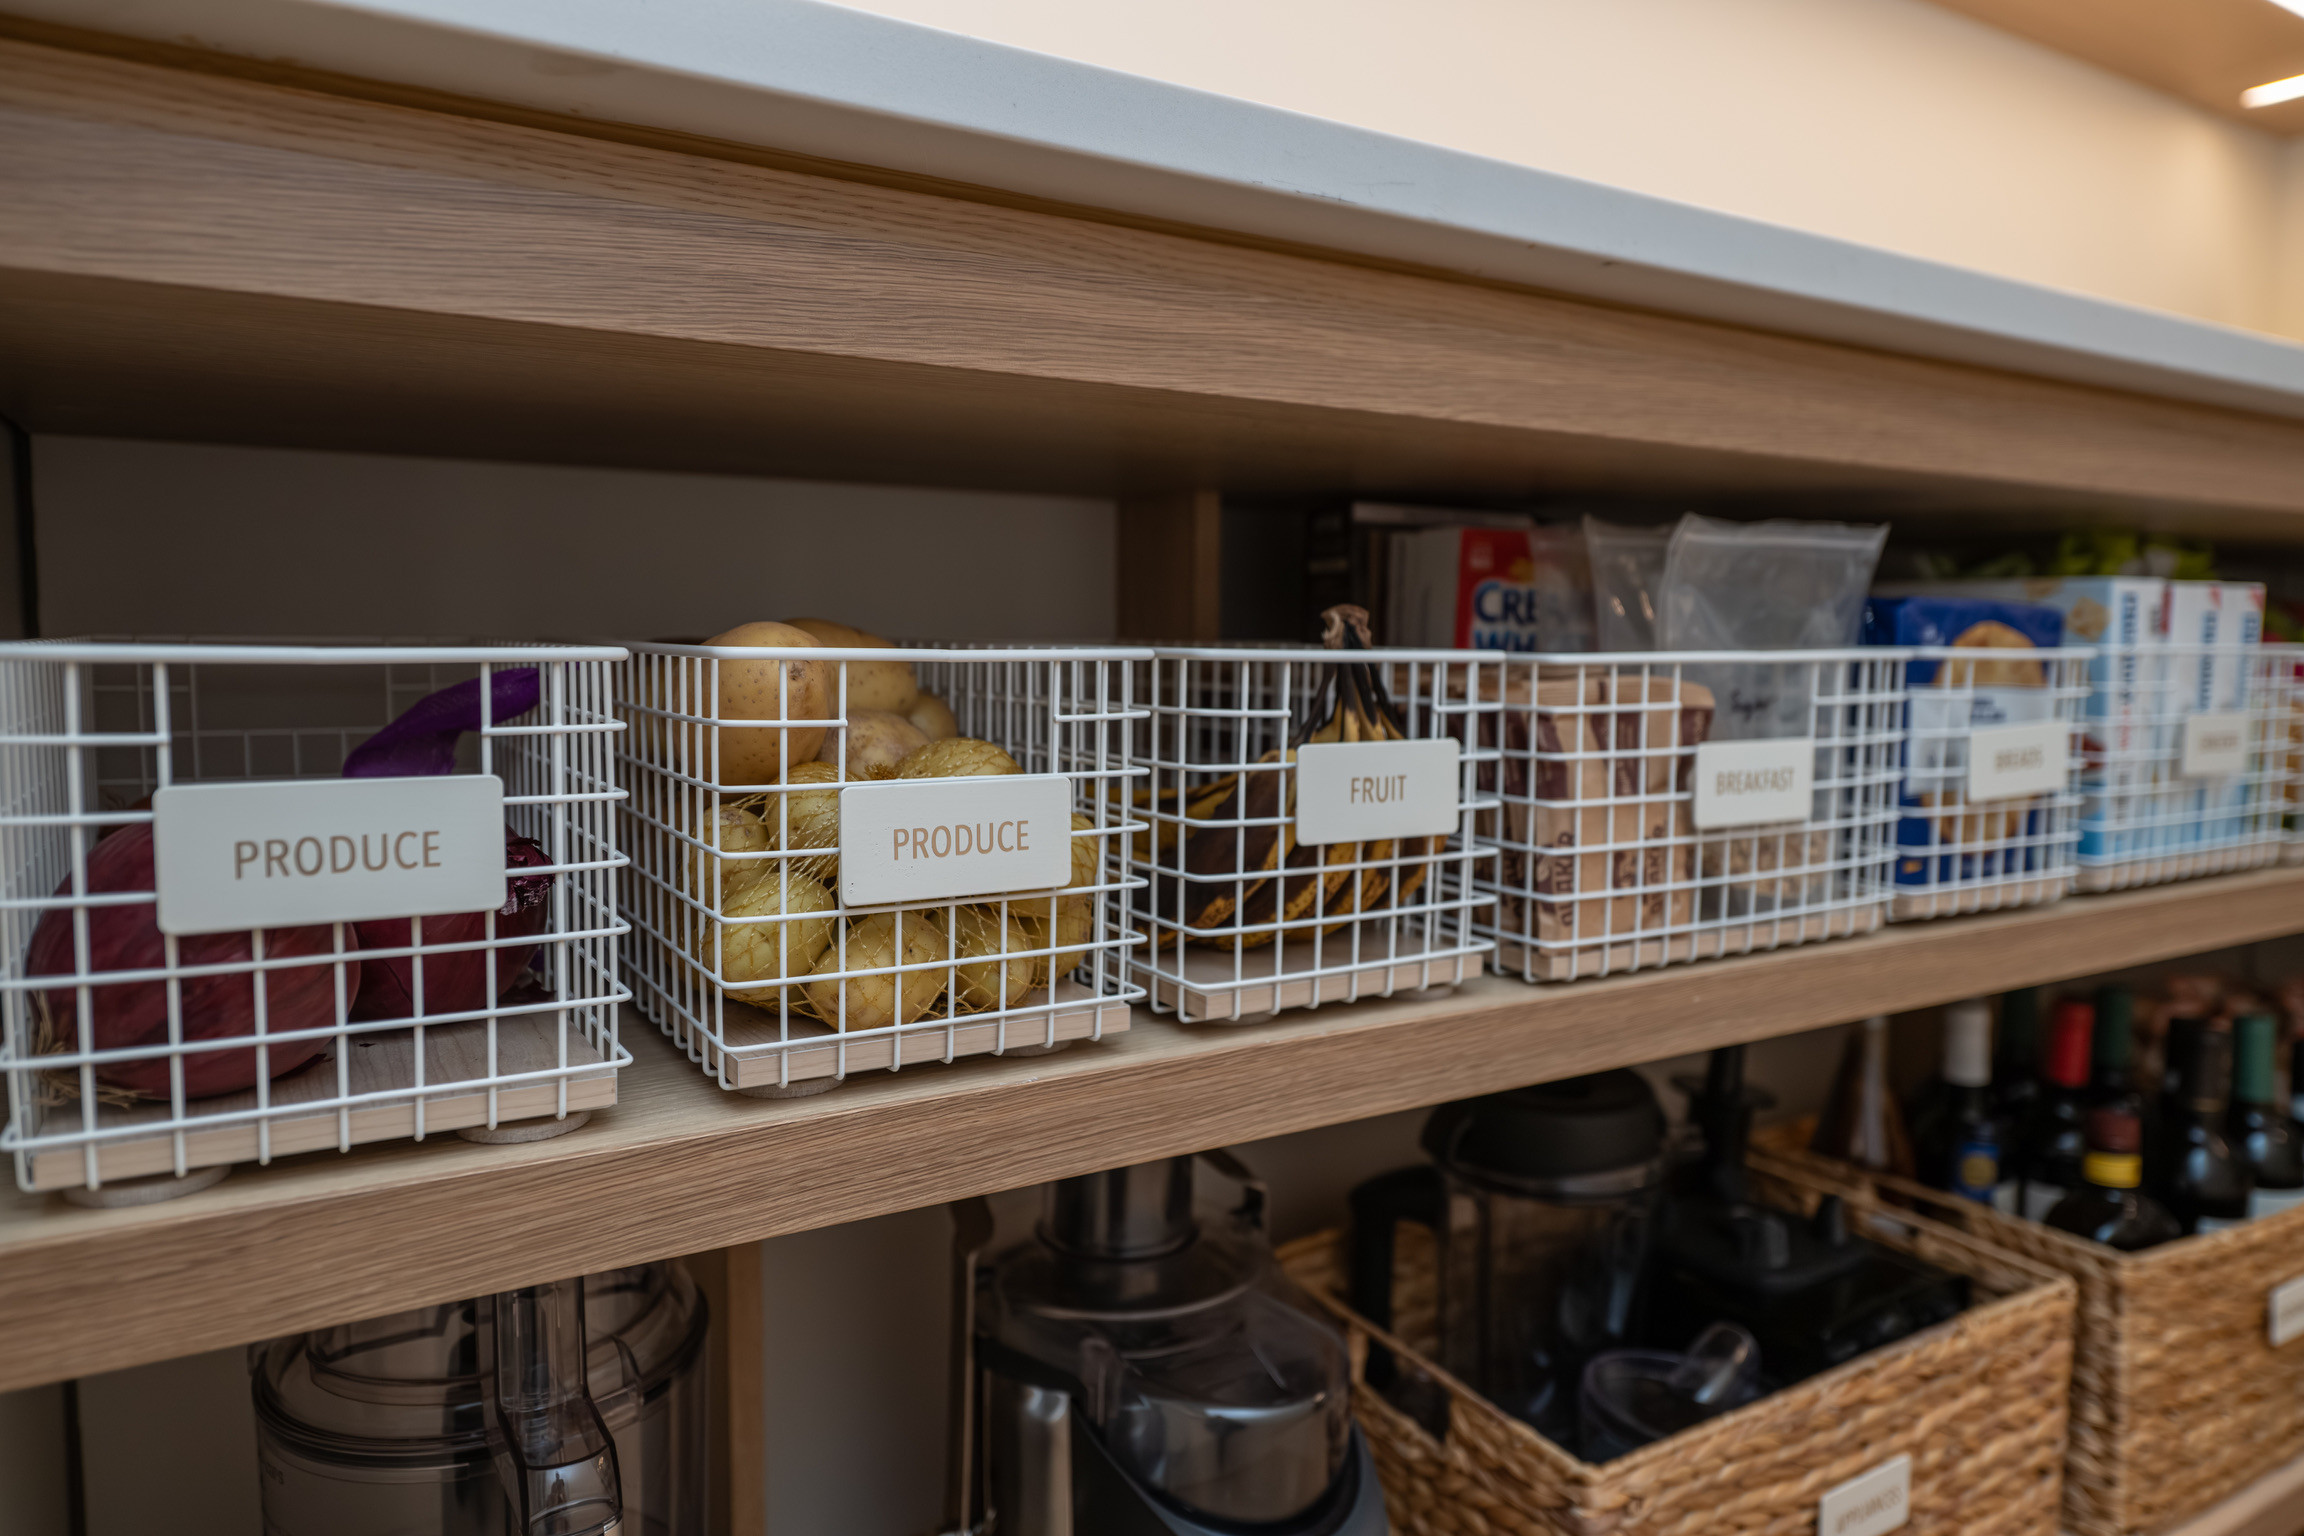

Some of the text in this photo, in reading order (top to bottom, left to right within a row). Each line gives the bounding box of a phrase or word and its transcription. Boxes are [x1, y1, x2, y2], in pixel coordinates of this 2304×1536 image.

[1350, 774, 1407, 804] FRUIT
[1715, 766, 1795, 797] BREAKFAST
[234, 830, 442, 881] PRODUCE
[893, 819, 1030, 861] PRODUCE
